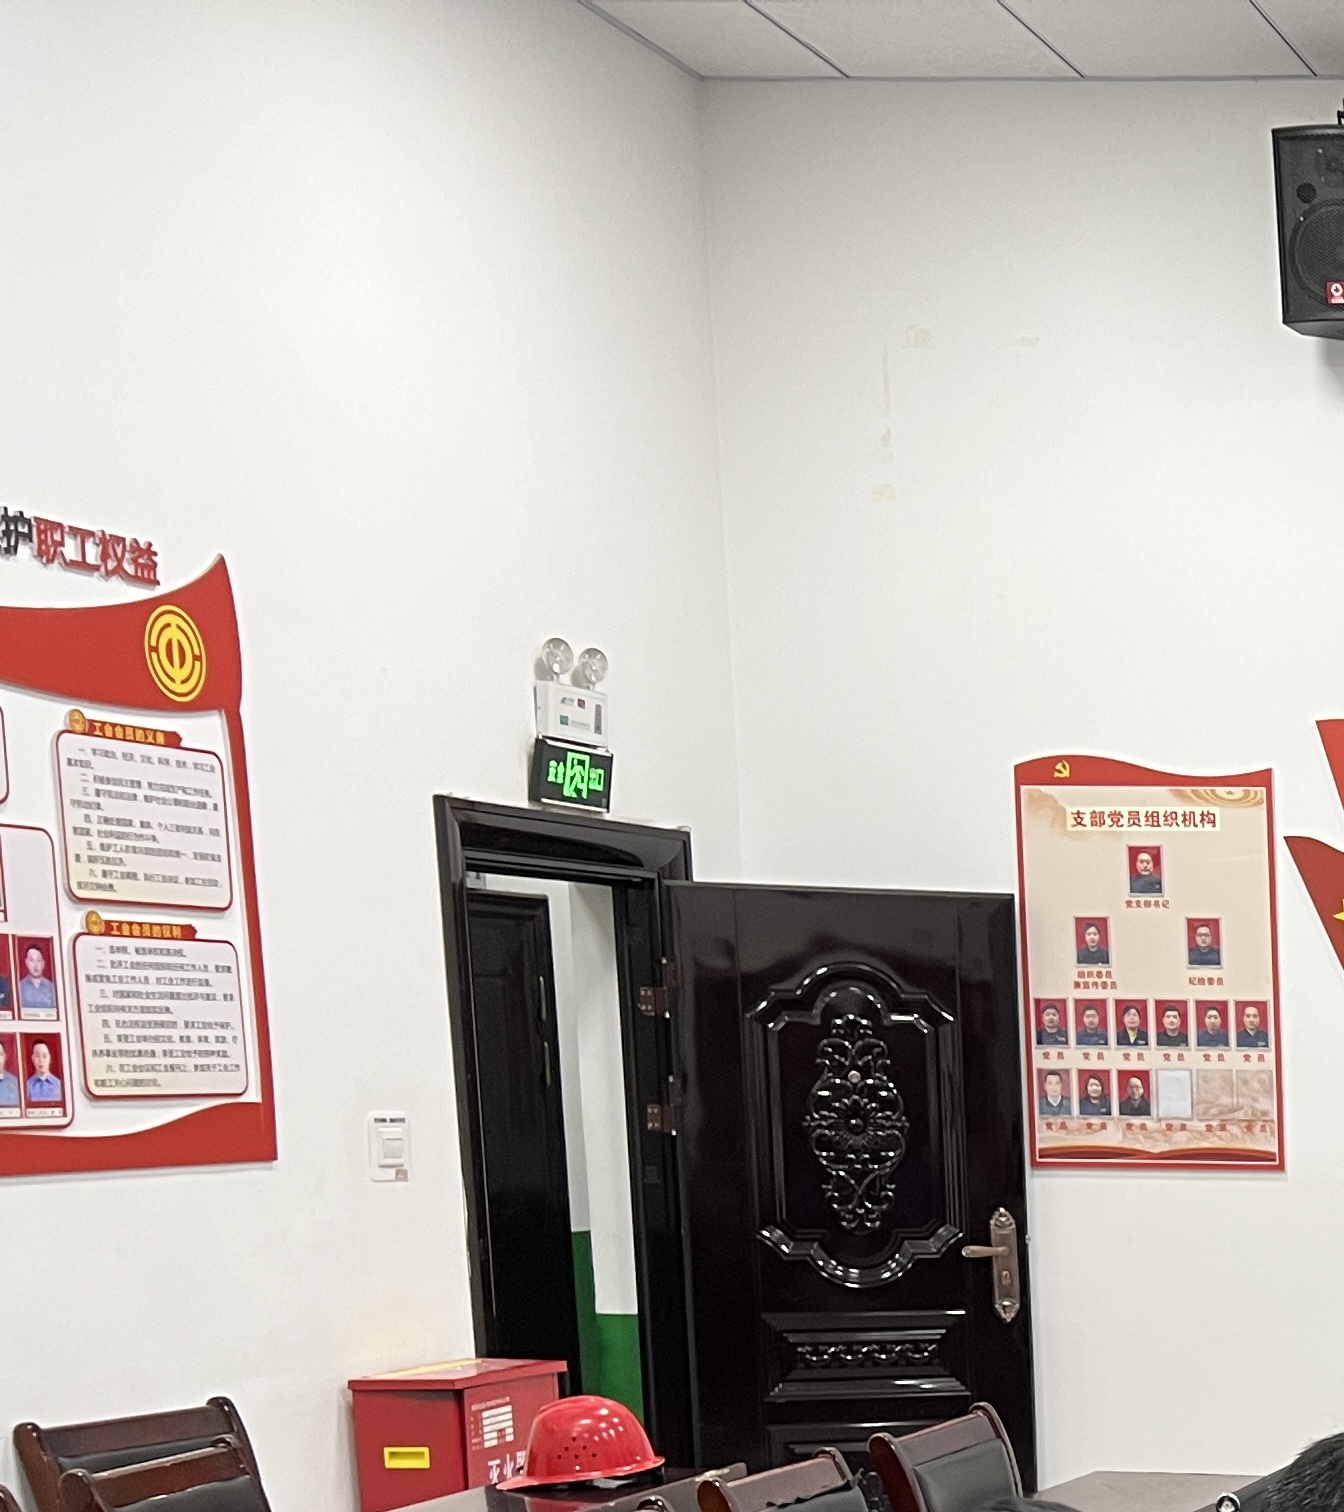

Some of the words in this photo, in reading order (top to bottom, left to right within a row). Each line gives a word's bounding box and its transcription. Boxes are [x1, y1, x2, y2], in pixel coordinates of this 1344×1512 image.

[1070, 809, 1218, 828] 支部党员组织机构
[1124, 899, 1170, 909] 党支部书记
[1076, 970, 1113, 979] 组织委员
[1188, 977, 1224, 986] 纪检委员
